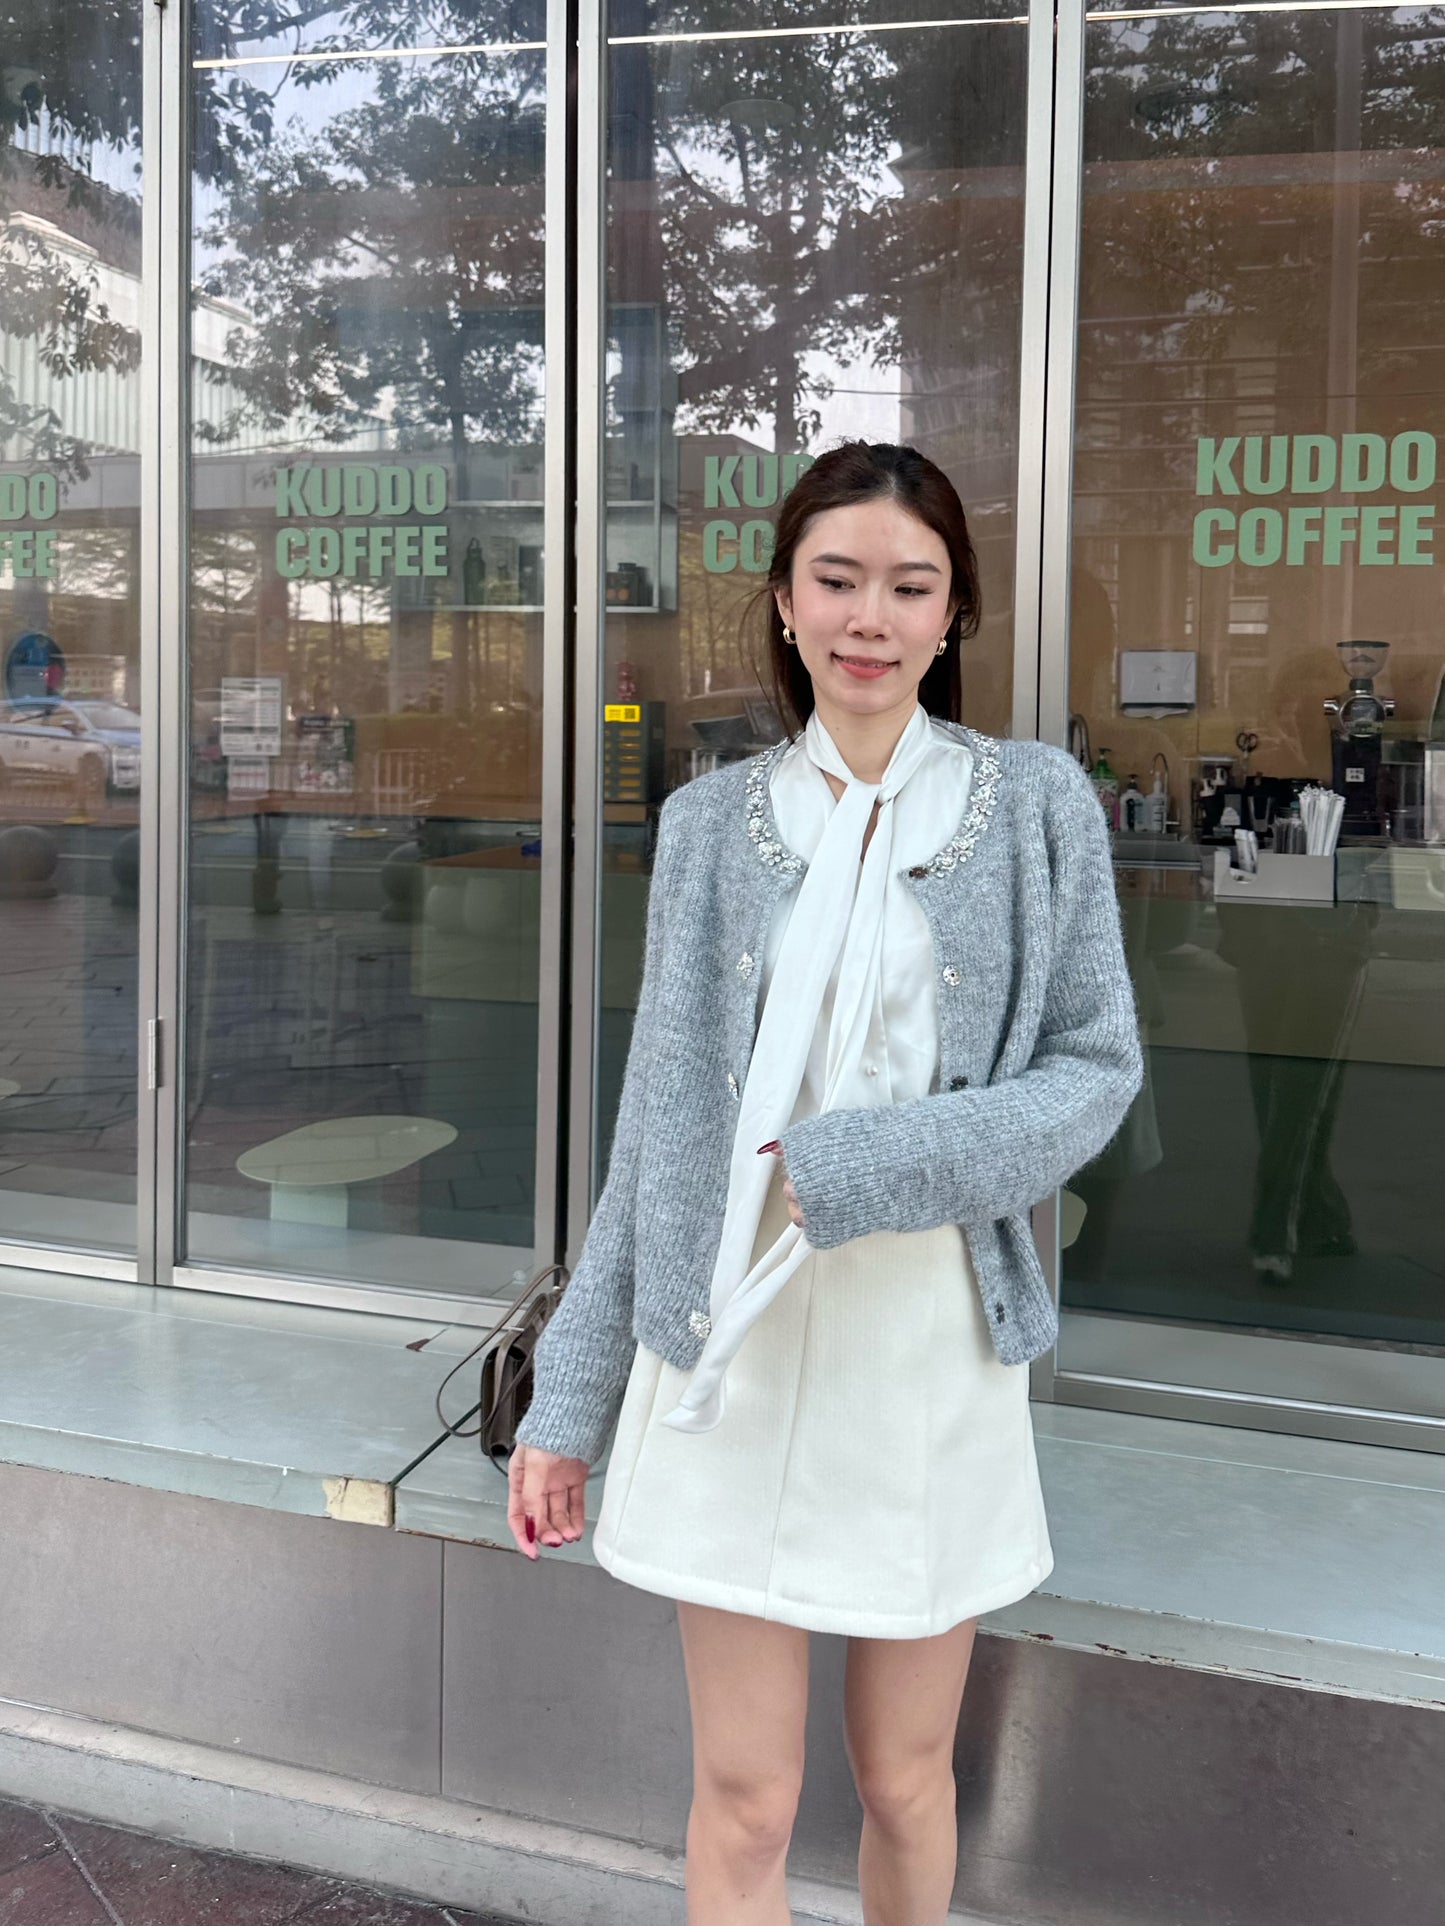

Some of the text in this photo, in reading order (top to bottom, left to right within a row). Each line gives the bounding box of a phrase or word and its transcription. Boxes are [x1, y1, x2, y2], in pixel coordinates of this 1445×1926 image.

[276, 464, 447, 517] KUDDO
[1196, 431, 1436, 495] KUDDO
[276, 526, 448, 578] COFFEE
[1193, 505, 1436, 567] COFFEE
